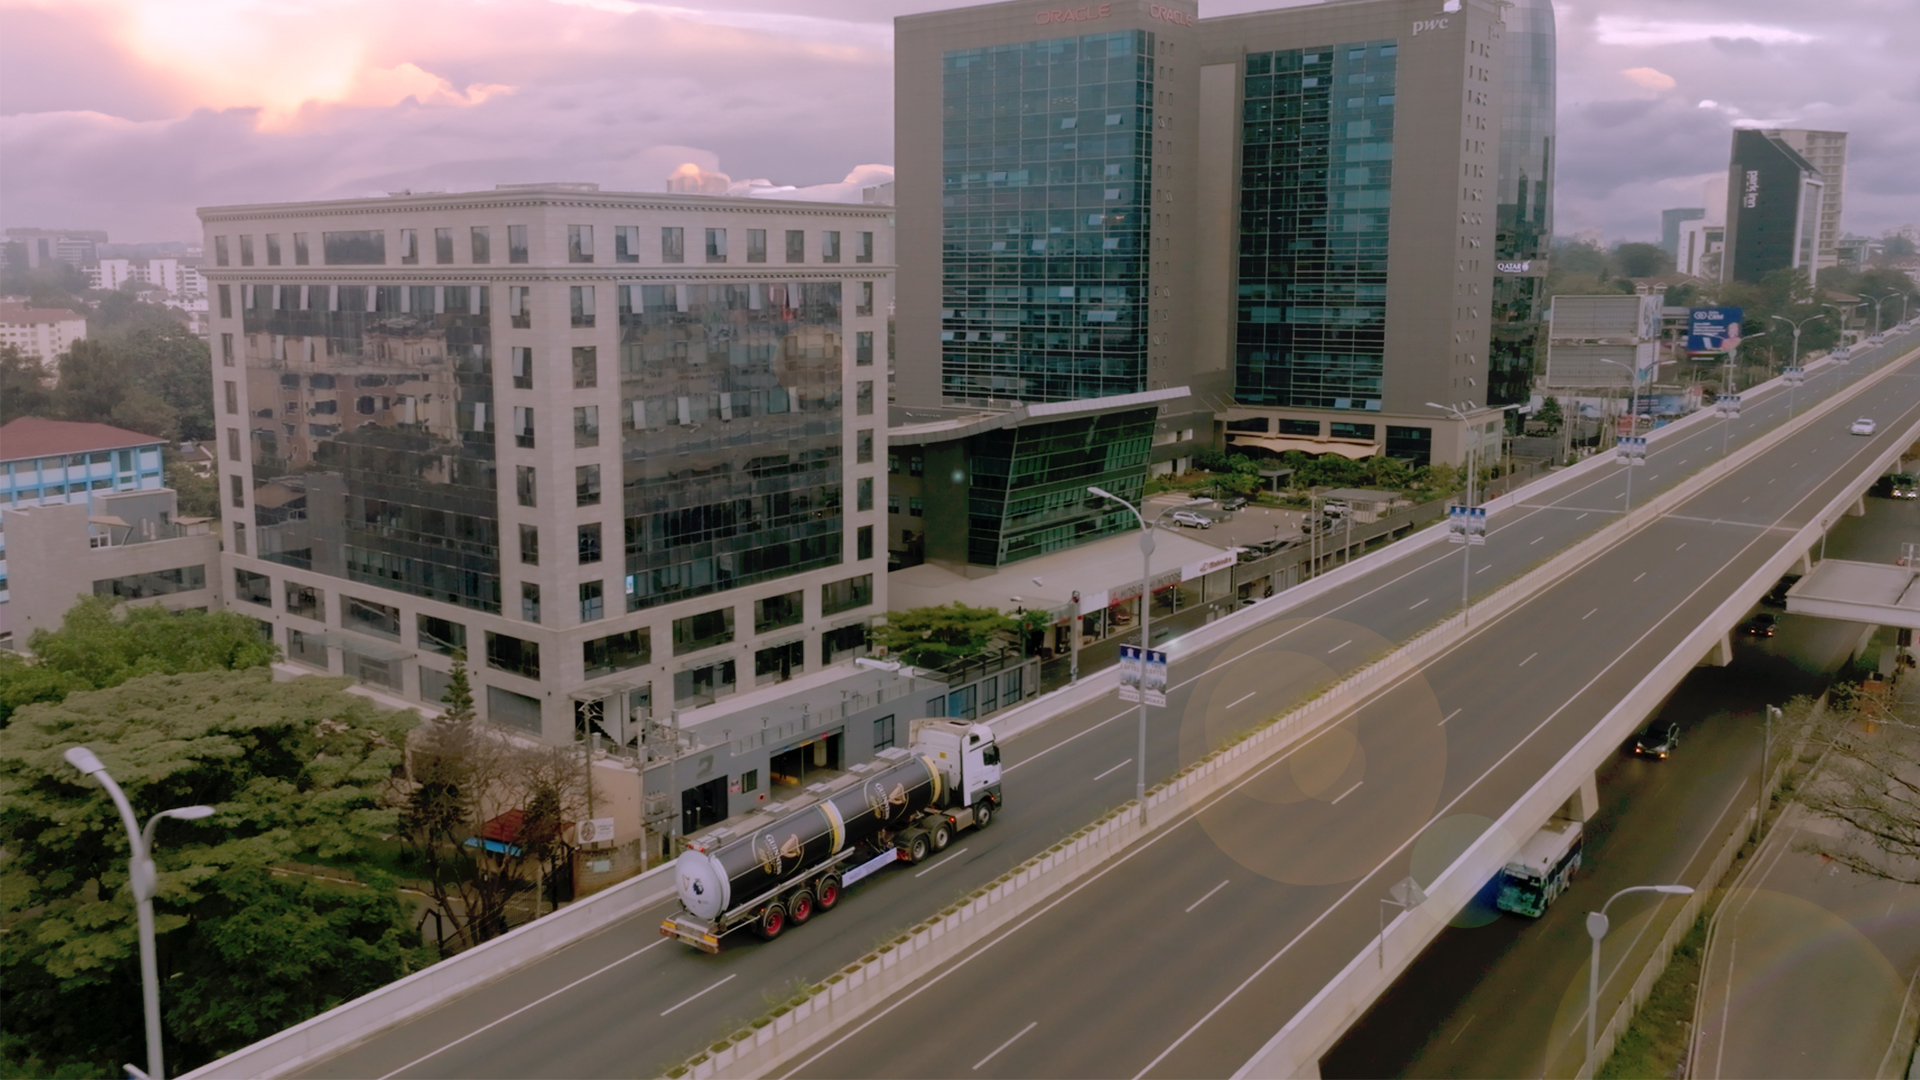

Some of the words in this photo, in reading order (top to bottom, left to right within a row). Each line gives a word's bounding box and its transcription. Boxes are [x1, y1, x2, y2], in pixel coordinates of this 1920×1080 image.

[1035, 3, 1112, 25] ORACLE
[1150, 3, 1195, 27] ORACLE
[1412, 18, 1449, 36] pwc
[1497, 262, 1522, 271] QATAR
[765, 834, 783, 875] GUINNESS
